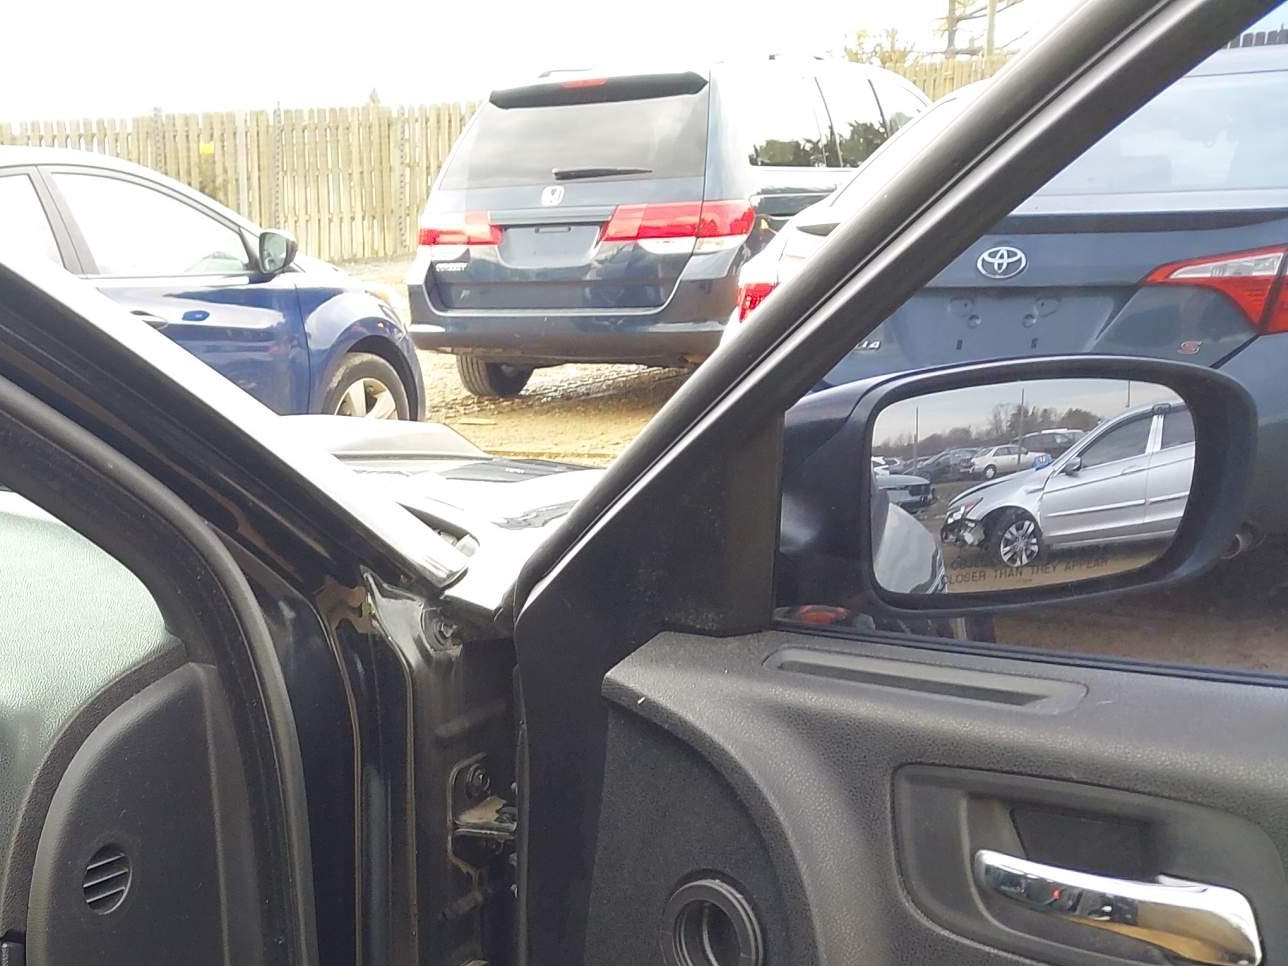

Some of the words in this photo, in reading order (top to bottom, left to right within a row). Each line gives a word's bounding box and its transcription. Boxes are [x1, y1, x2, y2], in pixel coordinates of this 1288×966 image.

[993, 568, 1023, 580] THAN
[1031, 565, 1057, 577] THEY
[1064, 560, 1109, 572] APPEAR
